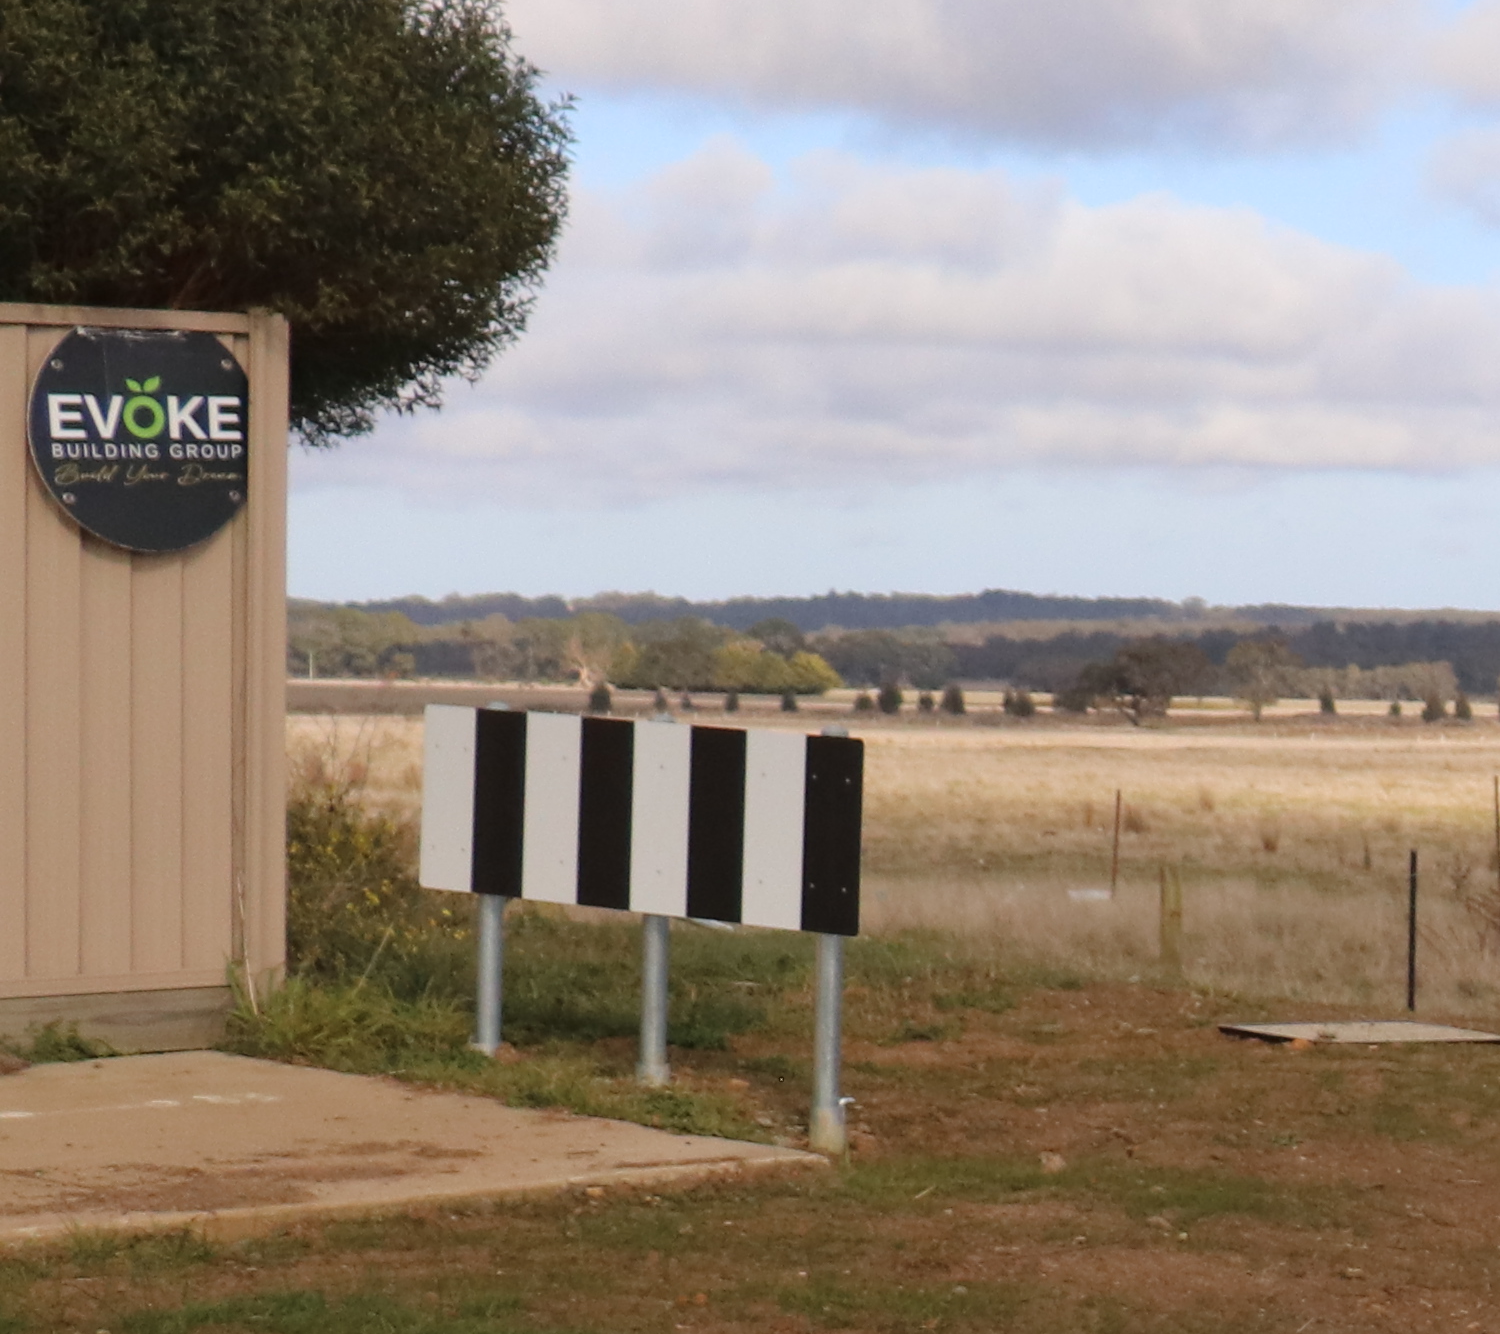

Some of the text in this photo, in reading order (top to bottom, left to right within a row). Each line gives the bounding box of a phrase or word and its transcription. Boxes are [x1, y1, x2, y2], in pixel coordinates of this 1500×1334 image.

[48, 393, 243, 440] EVOKE
[51, 443, 243, 459] BUILDING GROUP
[123, 464, 169, 486] Your
